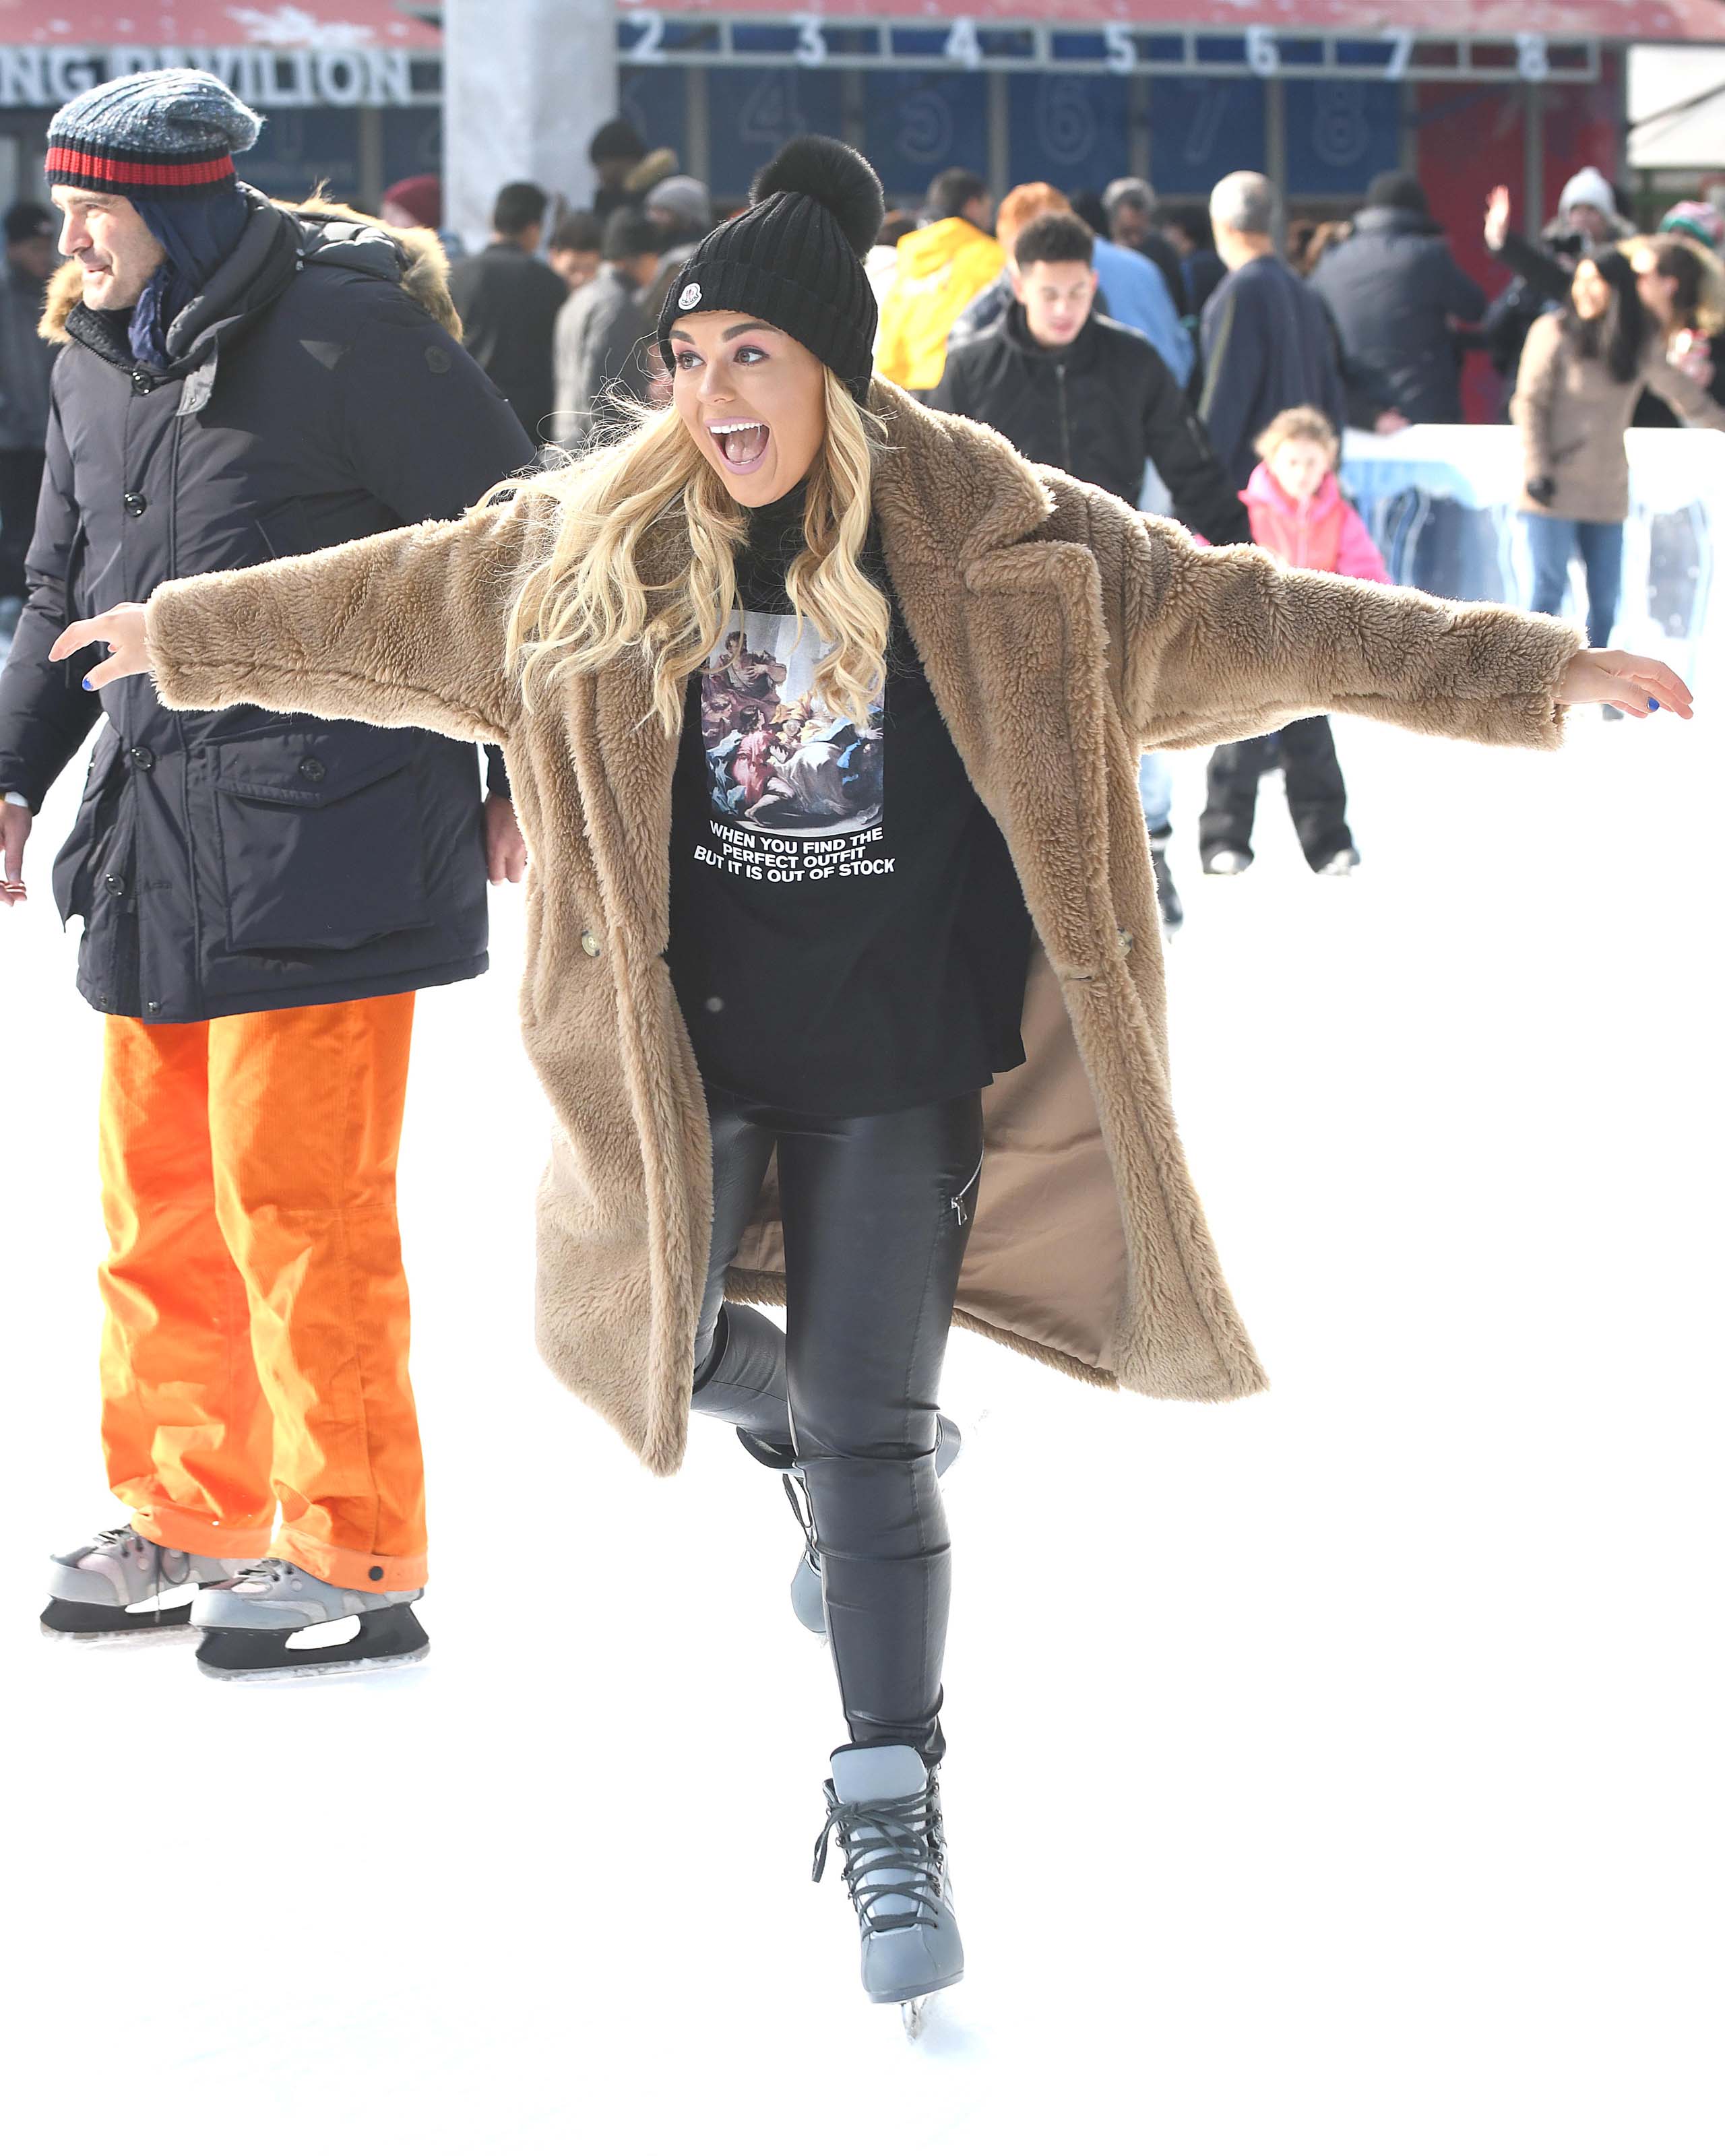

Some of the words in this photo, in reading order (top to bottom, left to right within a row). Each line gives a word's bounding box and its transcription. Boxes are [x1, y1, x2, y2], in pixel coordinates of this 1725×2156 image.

[629, 10, 666, 63] 2
[791, 13, 827, 65] 3
[945, 17, 982, 67] 4
[1104, 23, 1137, 75] 5
[1245, 26, 1279, 77] 6
[1380, 28, 1414, 81] 7
[1515, 31, 1549, 82] 8
[710, 819, 755, 848] WHEN
[759, 837, 798, 854] YOU
[803, 839, 846, 854] FIND
[849, 827, 883, 846] THE
[723, 842, 798, 868] PERFECT
[803, 846, 866, 868] OUTFIT
[693, 845, 724, 869] BUT
[728, 860, 742, 875] IT
[746, 864, 763, 880] IS
[767, 869, 805, 883] OUT
[809, 866, 835, 880] OF
[839, 858, 896, 877] STOCK
